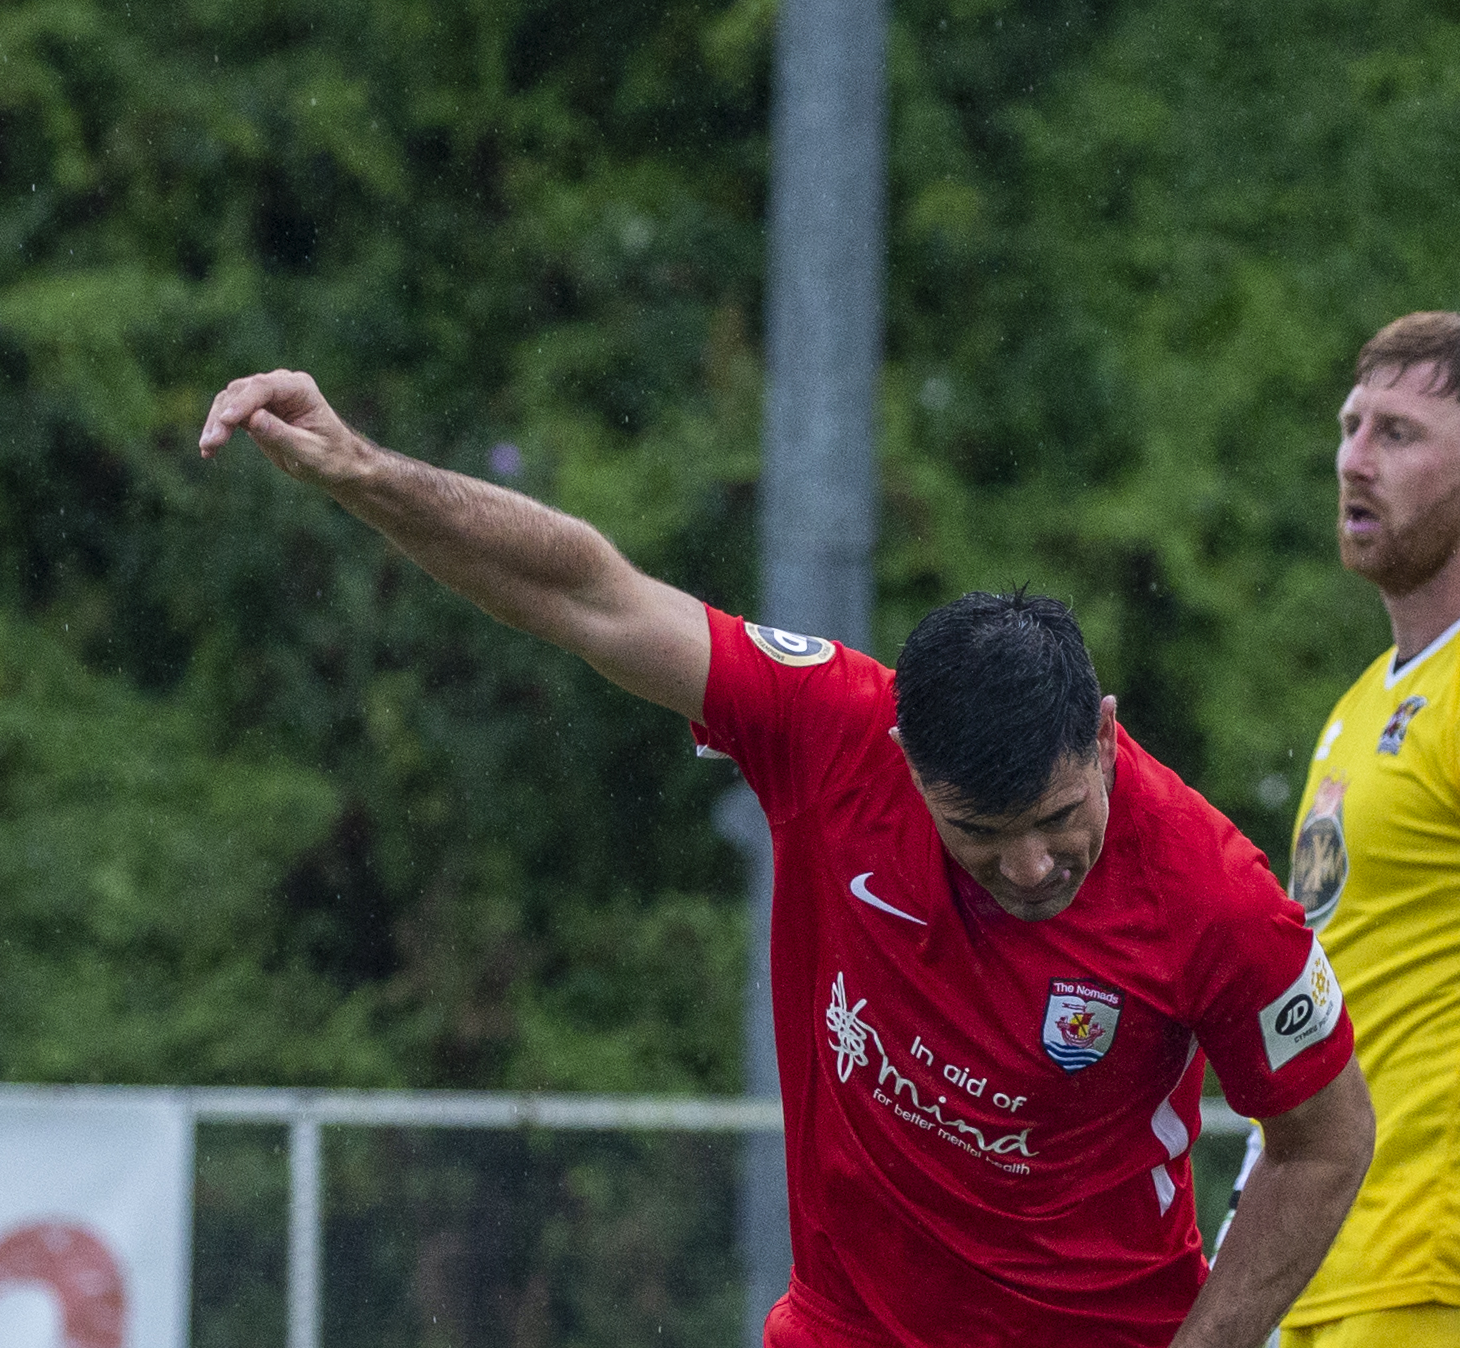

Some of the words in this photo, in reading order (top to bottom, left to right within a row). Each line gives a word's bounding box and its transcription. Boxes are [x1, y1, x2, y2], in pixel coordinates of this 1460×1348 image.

[1053, 982, 1074, 993] The
[1075, 984, 1119, 1005] Nomads
[1281, 999, 1309, 1034] JD
[909, 1035, 934, 1067] In
[943, 1064, 988, 1098] aid
[992, 1092, 1028, 1113] of
[872, 1088, 893, 1107] for
[894, 1103, 937, 1131] better
[937, 1127, 982, 1158] mental
